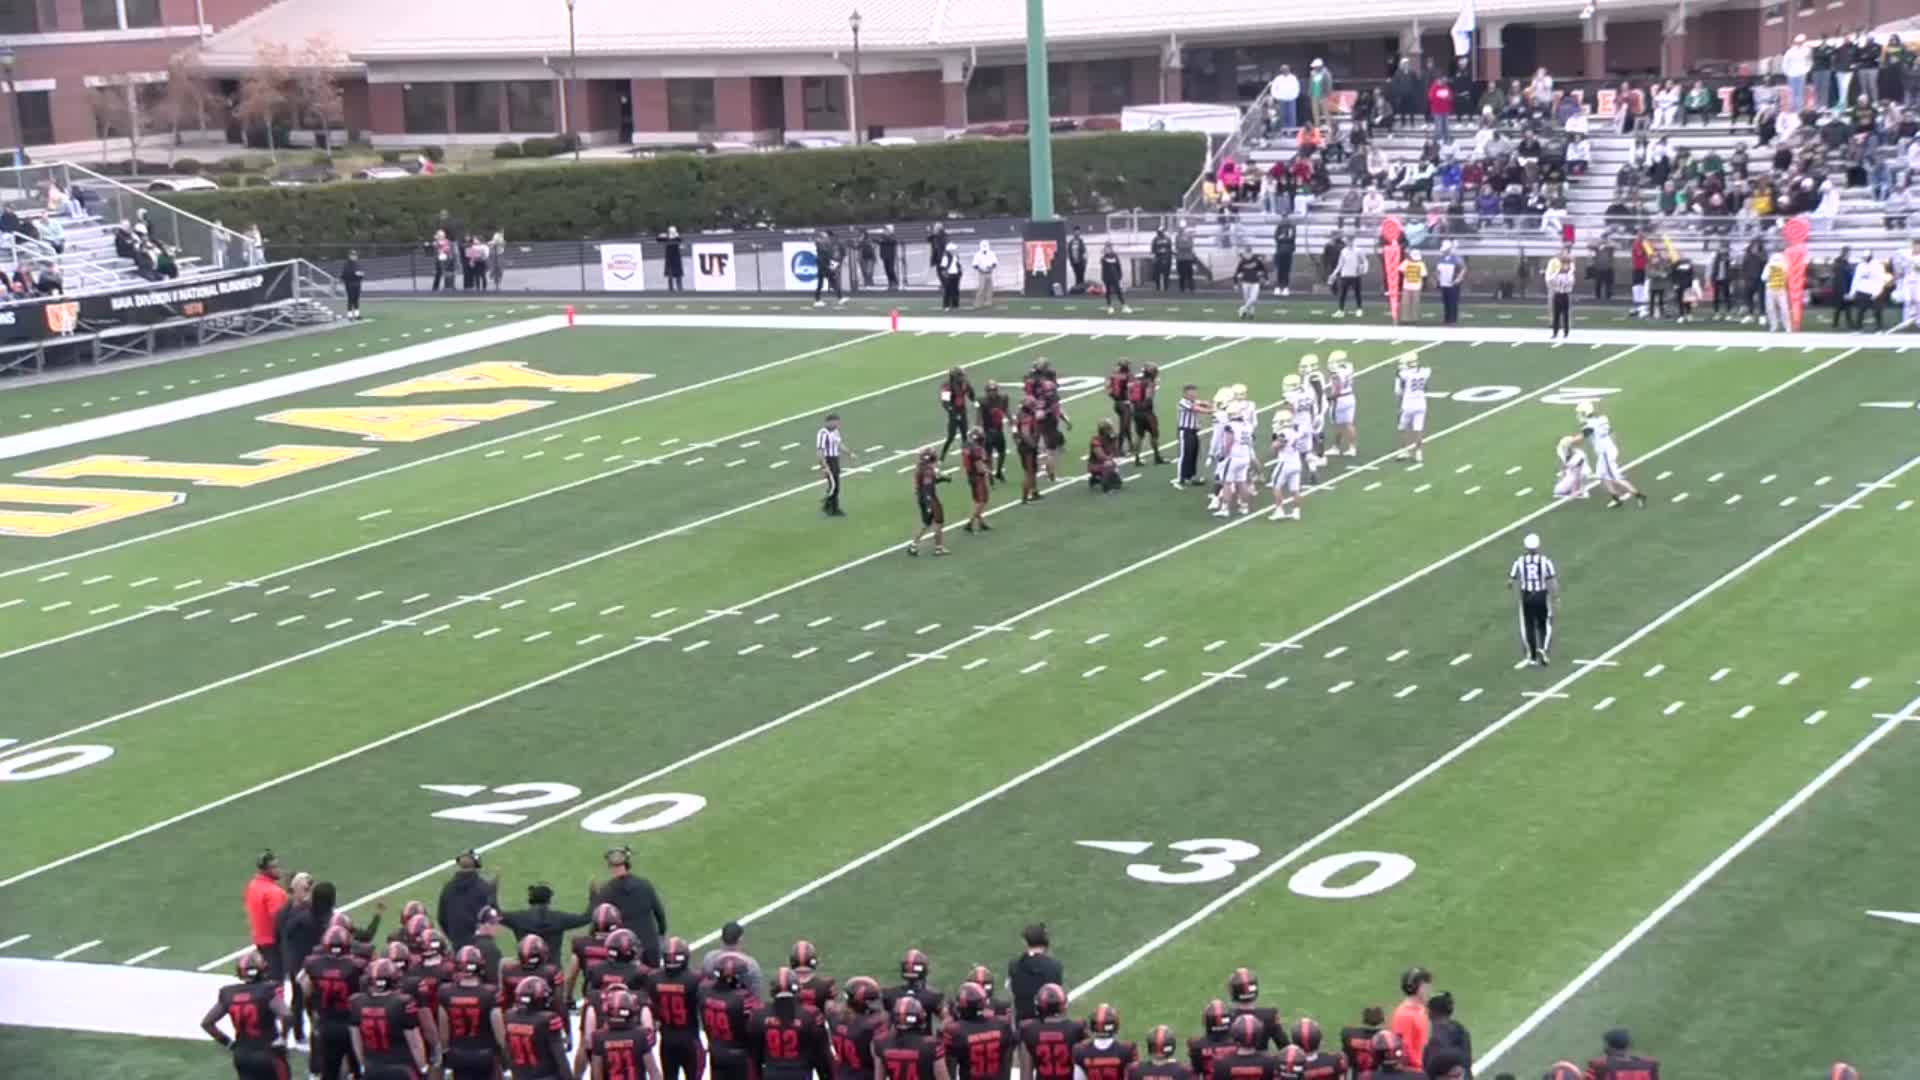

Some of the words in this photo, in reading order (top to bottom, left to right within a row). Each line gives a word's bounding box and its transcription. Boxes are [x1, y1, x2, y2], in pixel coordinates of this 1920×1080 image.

[698, 253, 730, 276] UF
[1526, 563, 1539, 580] R
[432, 782, 708, 834] 20
[1126, 837, 1417, 899] 30
